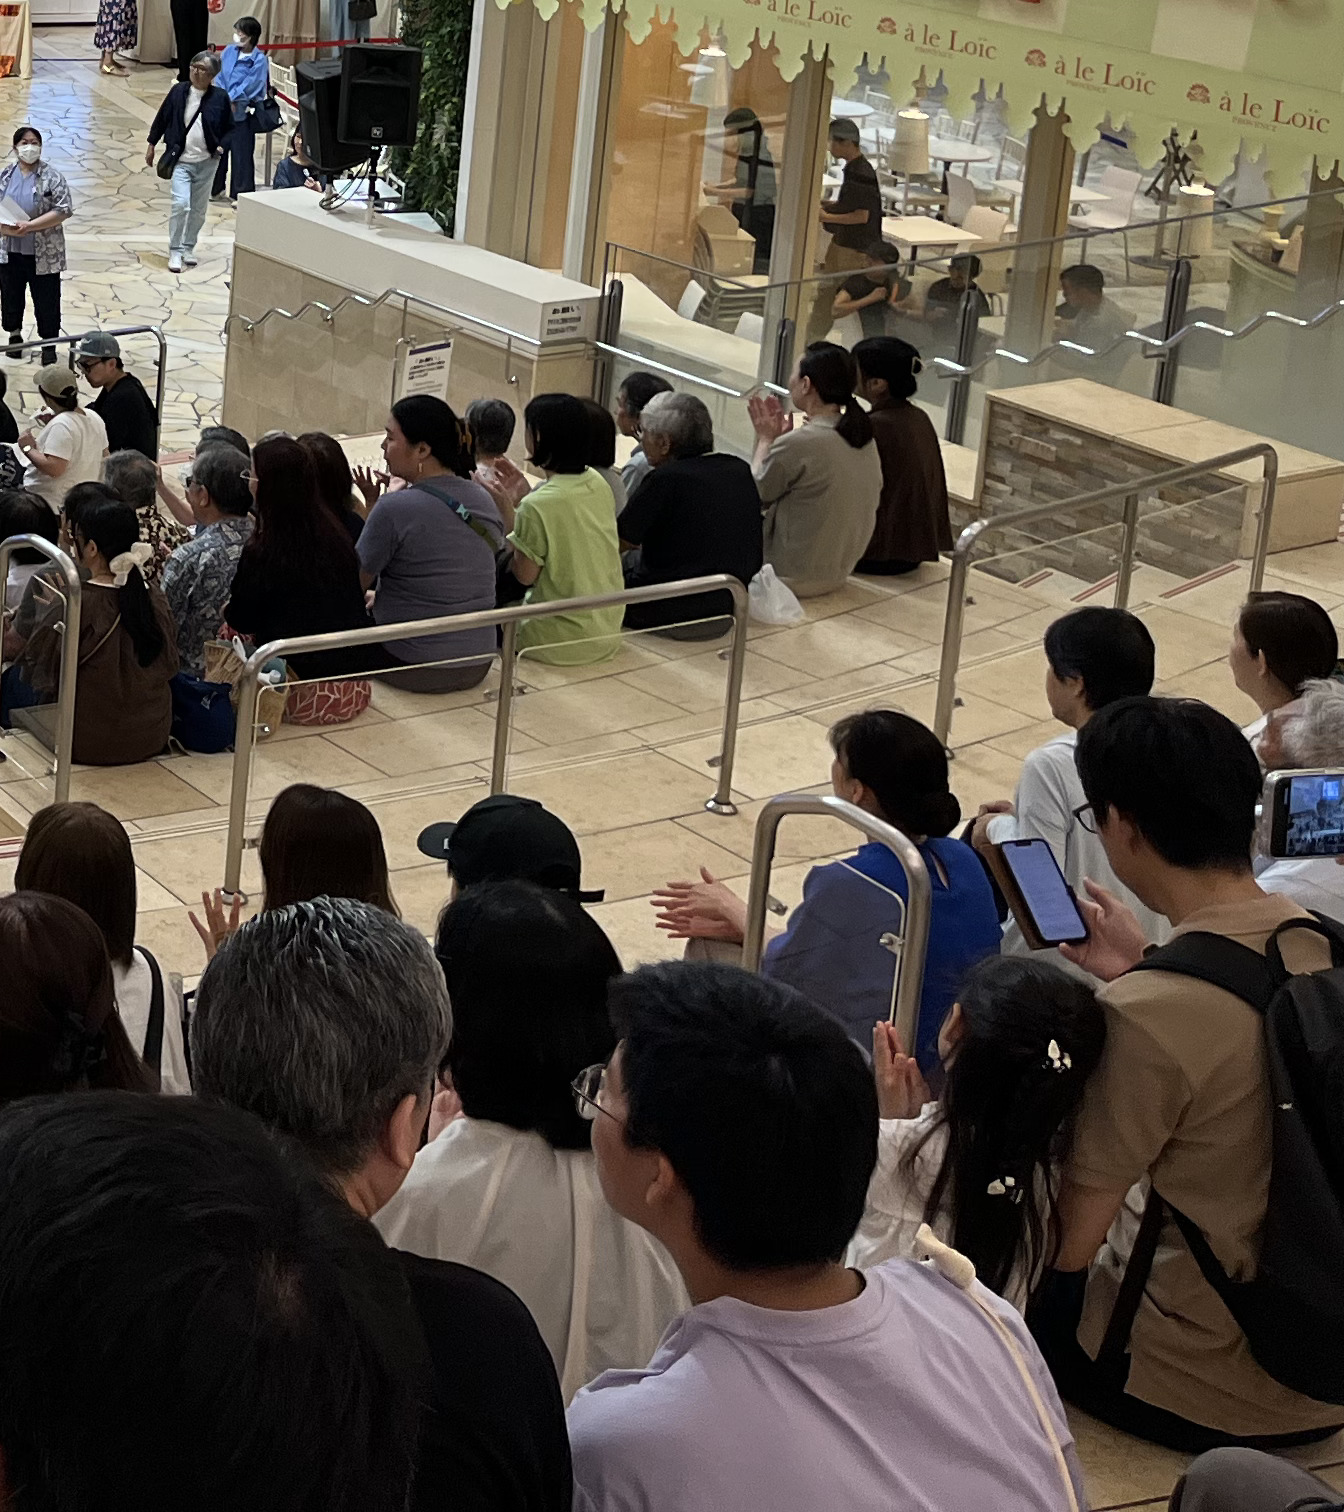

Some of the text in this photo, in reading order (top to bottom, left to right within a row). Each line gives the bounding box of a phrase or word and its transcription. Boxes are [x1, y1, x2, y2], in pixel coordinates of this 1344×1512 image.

[807, 0, 853, 29] Loïc
[922, 23, 941, 48] le
[949, 29, 999, 61] Loïc
[1074, 56, 1096, 83] le
[1103, 62, 1157, 96] Loïc
[1240, 92, 1264, 119] le
[1272, 98, 1331, 134] Loïc
